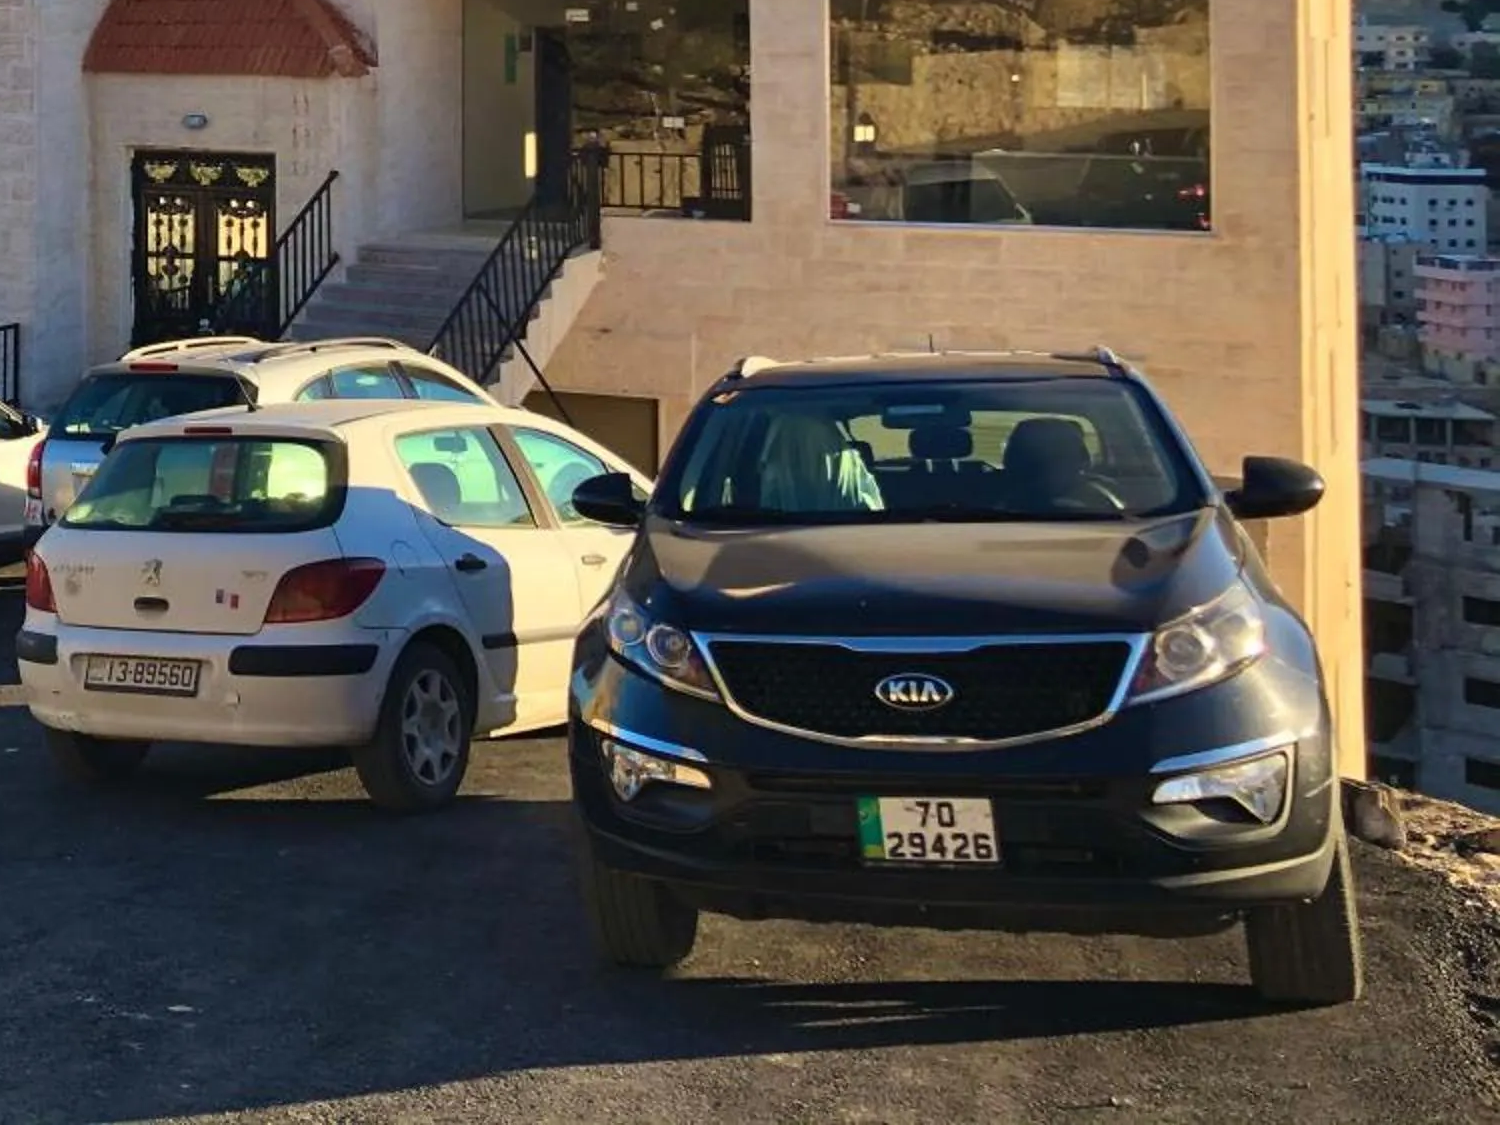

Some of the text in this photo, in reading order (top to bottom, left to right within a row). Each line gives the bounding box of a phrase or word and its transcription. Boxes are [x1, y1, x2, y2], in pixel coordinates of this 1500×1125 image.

[107, 660, 194, 688] 13-89560
[888, 679, 941, 702] KIA
[915, 801, 956, 828] 70
[886, 831, 993, 860] 29426
